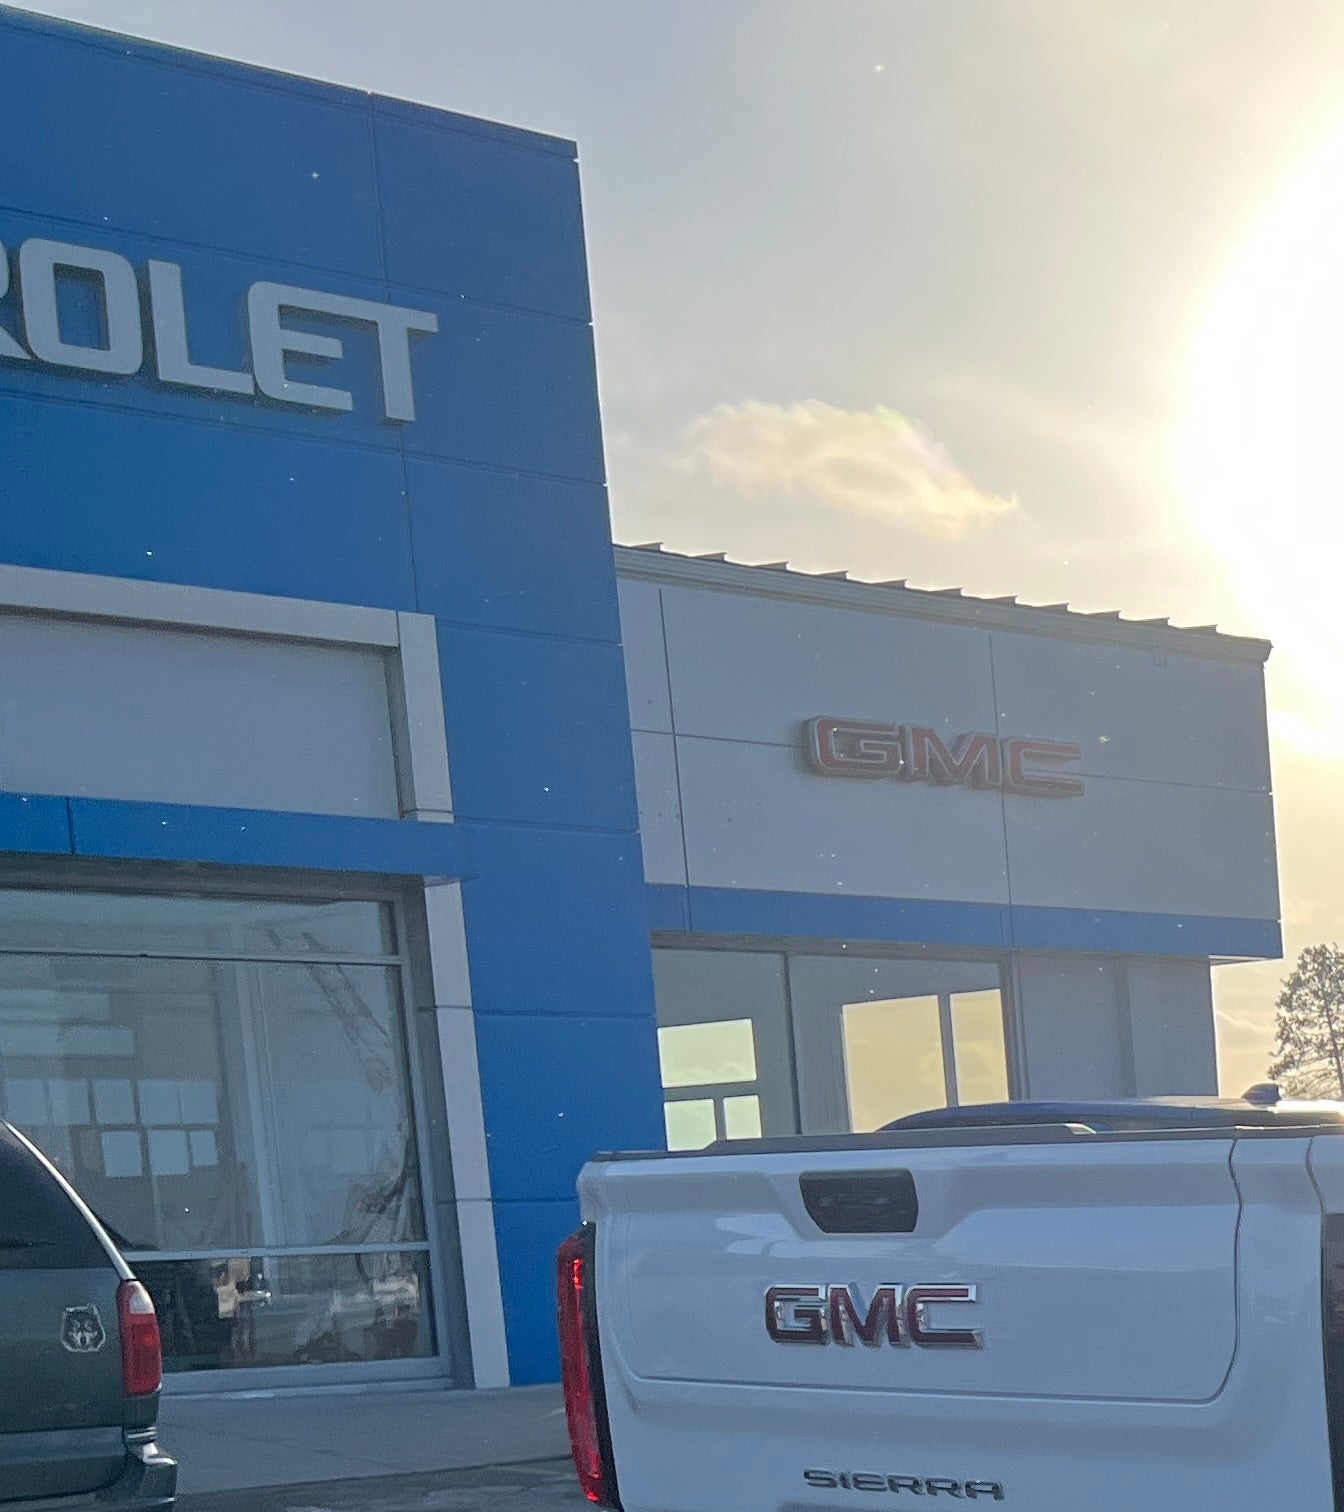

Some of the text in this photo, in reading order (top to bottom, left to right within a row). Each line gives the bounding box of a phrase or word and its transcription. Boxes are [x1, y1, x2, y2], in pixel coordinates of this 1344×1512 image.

[803, 715, 1085, 797] GMC
[764, 1282, 985, 1349] GMC
[803, 1468, 1005, 1501] SIERRA
